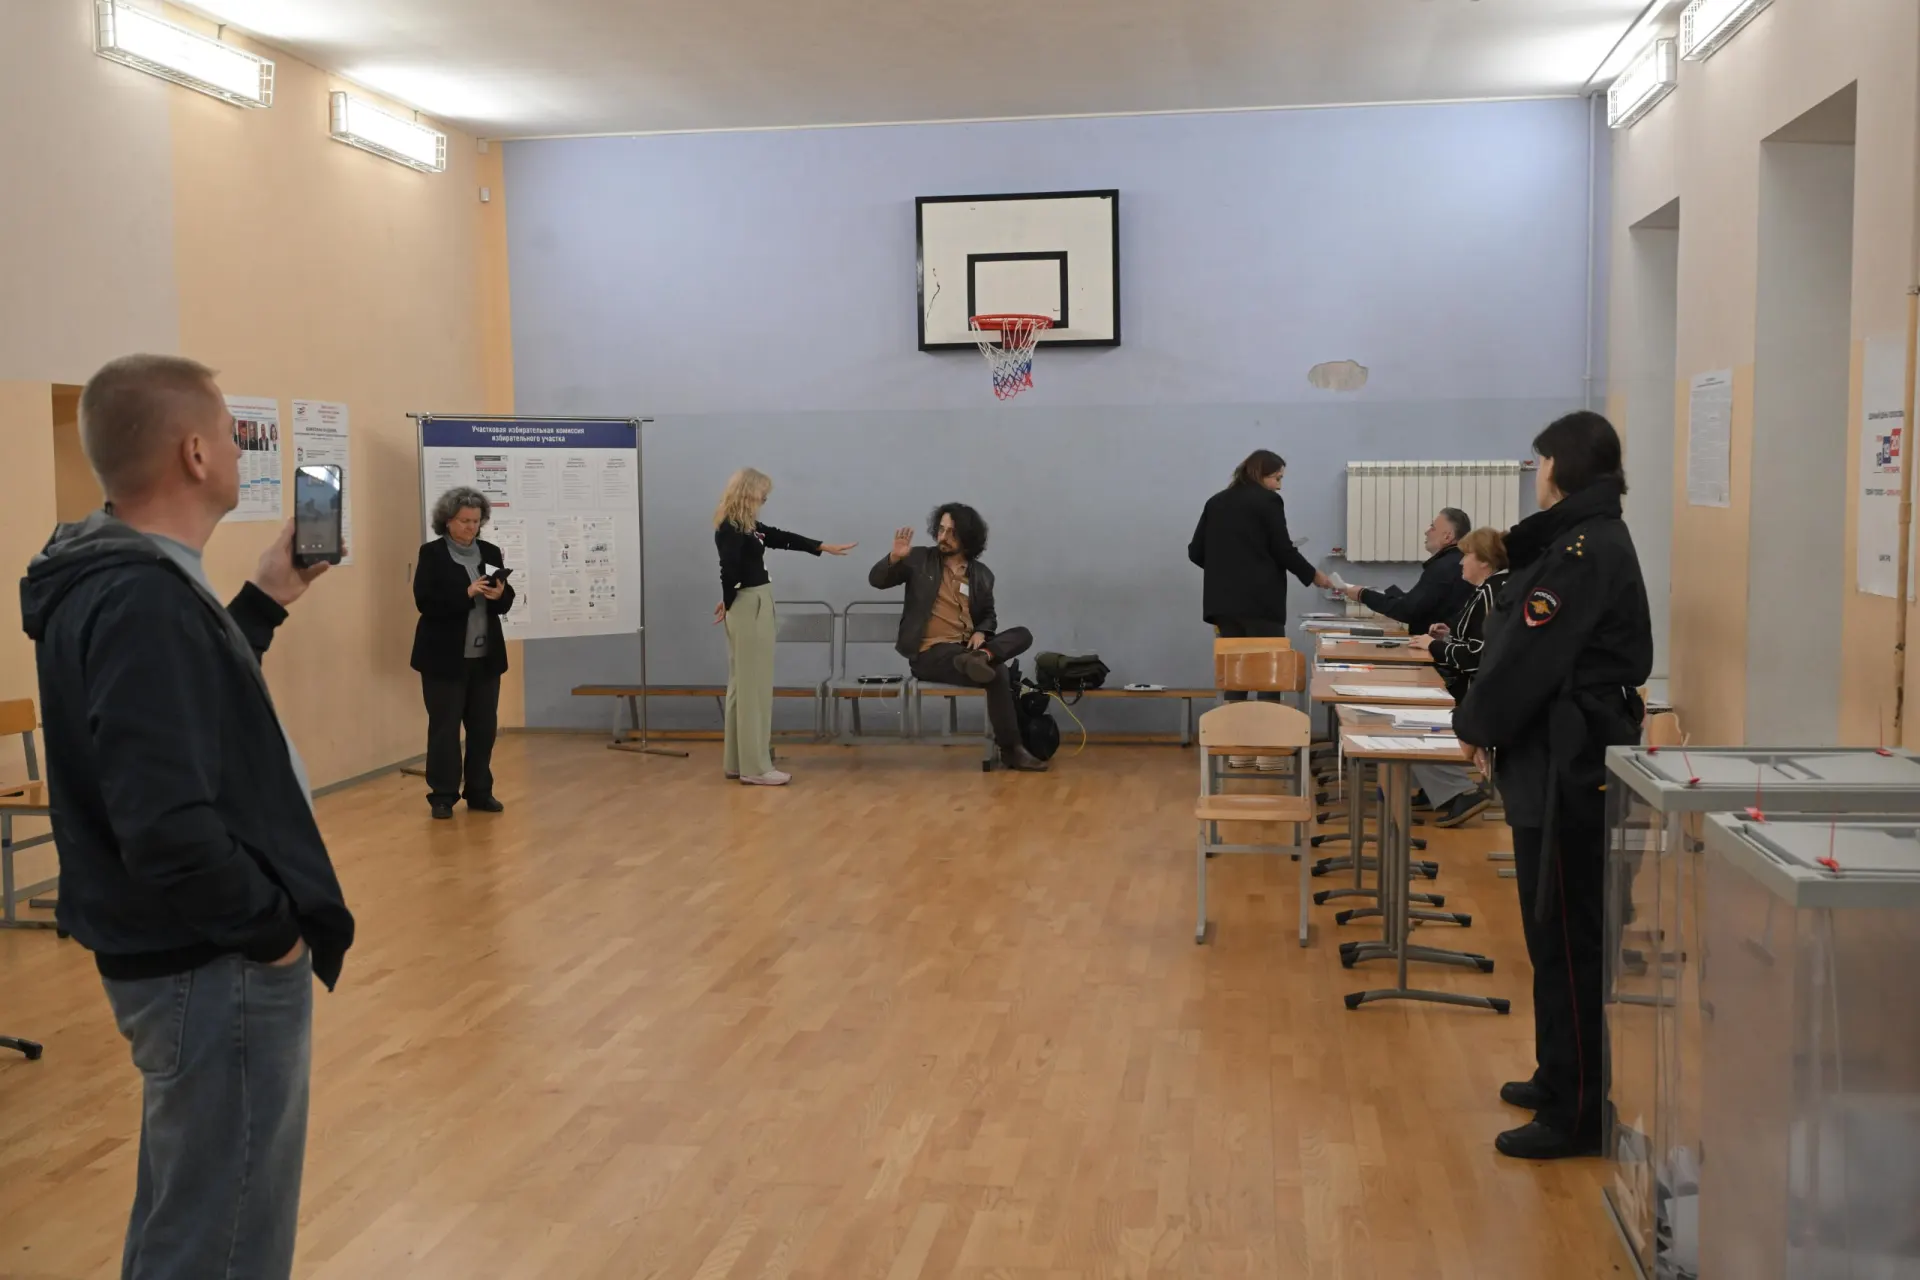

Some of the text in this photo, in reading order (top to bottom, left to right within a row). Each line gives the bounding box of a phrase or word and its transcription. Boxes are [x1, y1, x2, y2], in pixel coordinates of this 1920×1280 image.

[471, 426, 506, 434] Участковая
[508, 426, 554, 435] избирательная
[492, 434, 540, 443] избирательного
